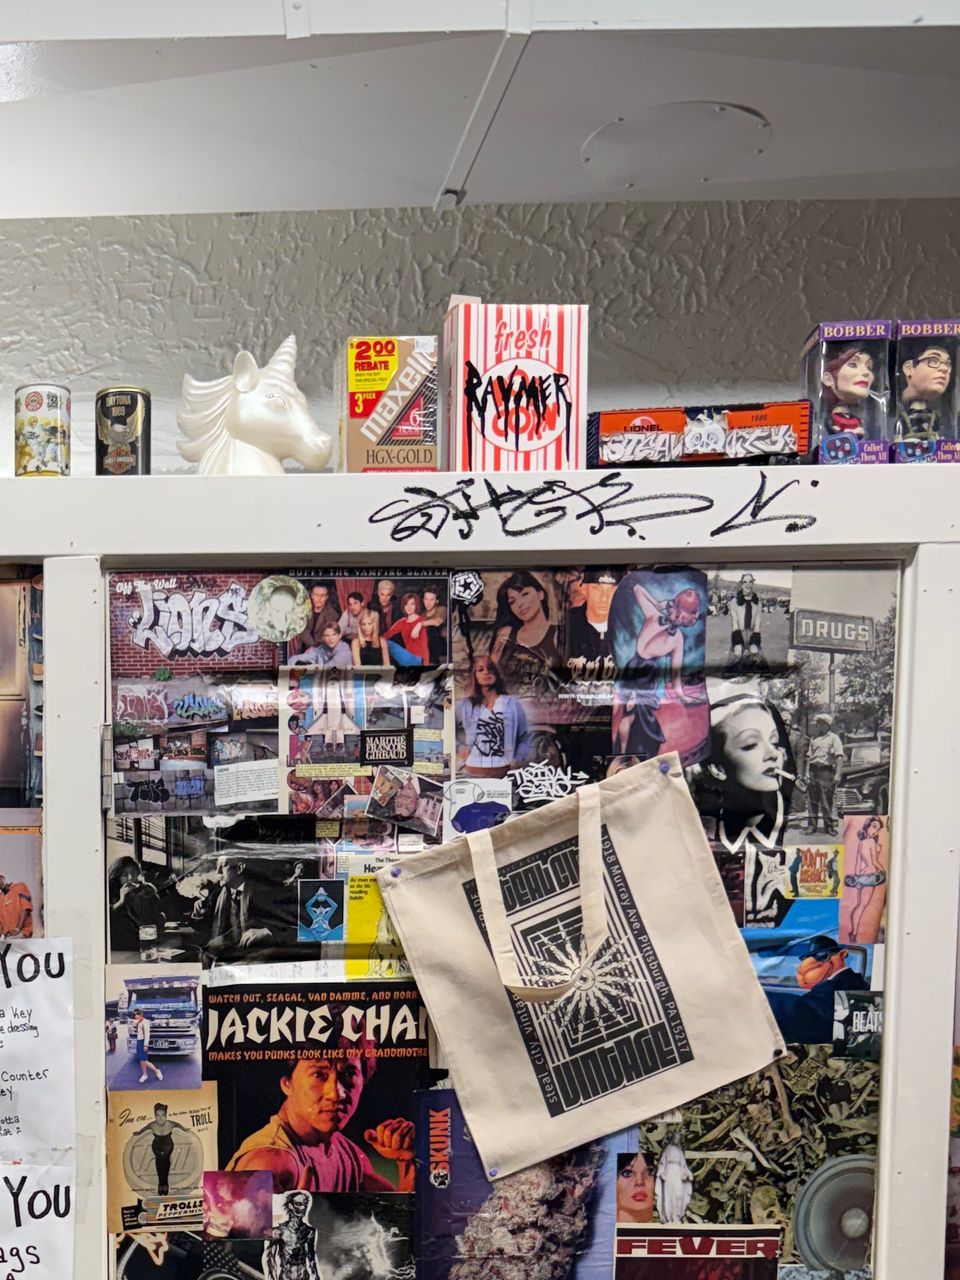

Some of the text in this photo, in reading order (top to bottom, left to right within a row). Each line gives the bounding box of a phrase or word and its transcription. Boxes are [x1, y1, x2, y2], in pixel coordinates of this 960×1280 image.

[494, 318, 553, 353] fresh
[823, 325, 886, 338] BOBBER
[354, 361, 390, 371] REBATE
[105, 395, 131, 408] DAYTONA
[354, 393, 363, 413] 3
[360, 349, 430, 442] maxell
[624, 424, 663, 432] LIONEL
[863, 443, 884, 452] Collect
[365, 450, 433, 465] HGX-GOLD
[860, 452, 887, 462] Them All
[116, 578, 177, 595] Off The Wall
[801, 619, 870, 642] DRUGS
[365, 750, 407, 761] GIRBAUD
[610, 864, 632, 907] Murray
[626, 908, 641, 935] Ave,
[638, 934, 669, 1001] Pittsburgh,
[665, 1002, 677, 1018] PA
[671, 1020, 690, 1053] 15217
[208, 994, 241, 1004] WATCH
[243, 994, 264, 1005] OUT,
[266, 993, 306, 1004] SEAGAL,
[308, 992, 327, 1002] VAN
[330, 991, 370, 1003] DAMME,
[372, 991, 391, 1001] AND
[8, 1022, 39, 1038] dressing
[206, 1004, 334, 1051] JACKIE
[208, 1051, 242, 1062] MAKES
[243, 1051, 264, 1061] YOU
[265, 1050, 296, 1061] PUNKS
[297, 1049, 321, 1060] LOOK
[323, 1049, 344, 1060] LIKE
[346, 1048, 363, 1060] MY
[190, 1113, 213, 1127] TROLL
[429, 1107, 451, 1173] SKUNK
[3, 1175, 71, 1228] YOU
[162, 1200, 204, 1213] TROLLS
[617, 1236, 780, 1260] FEVER
